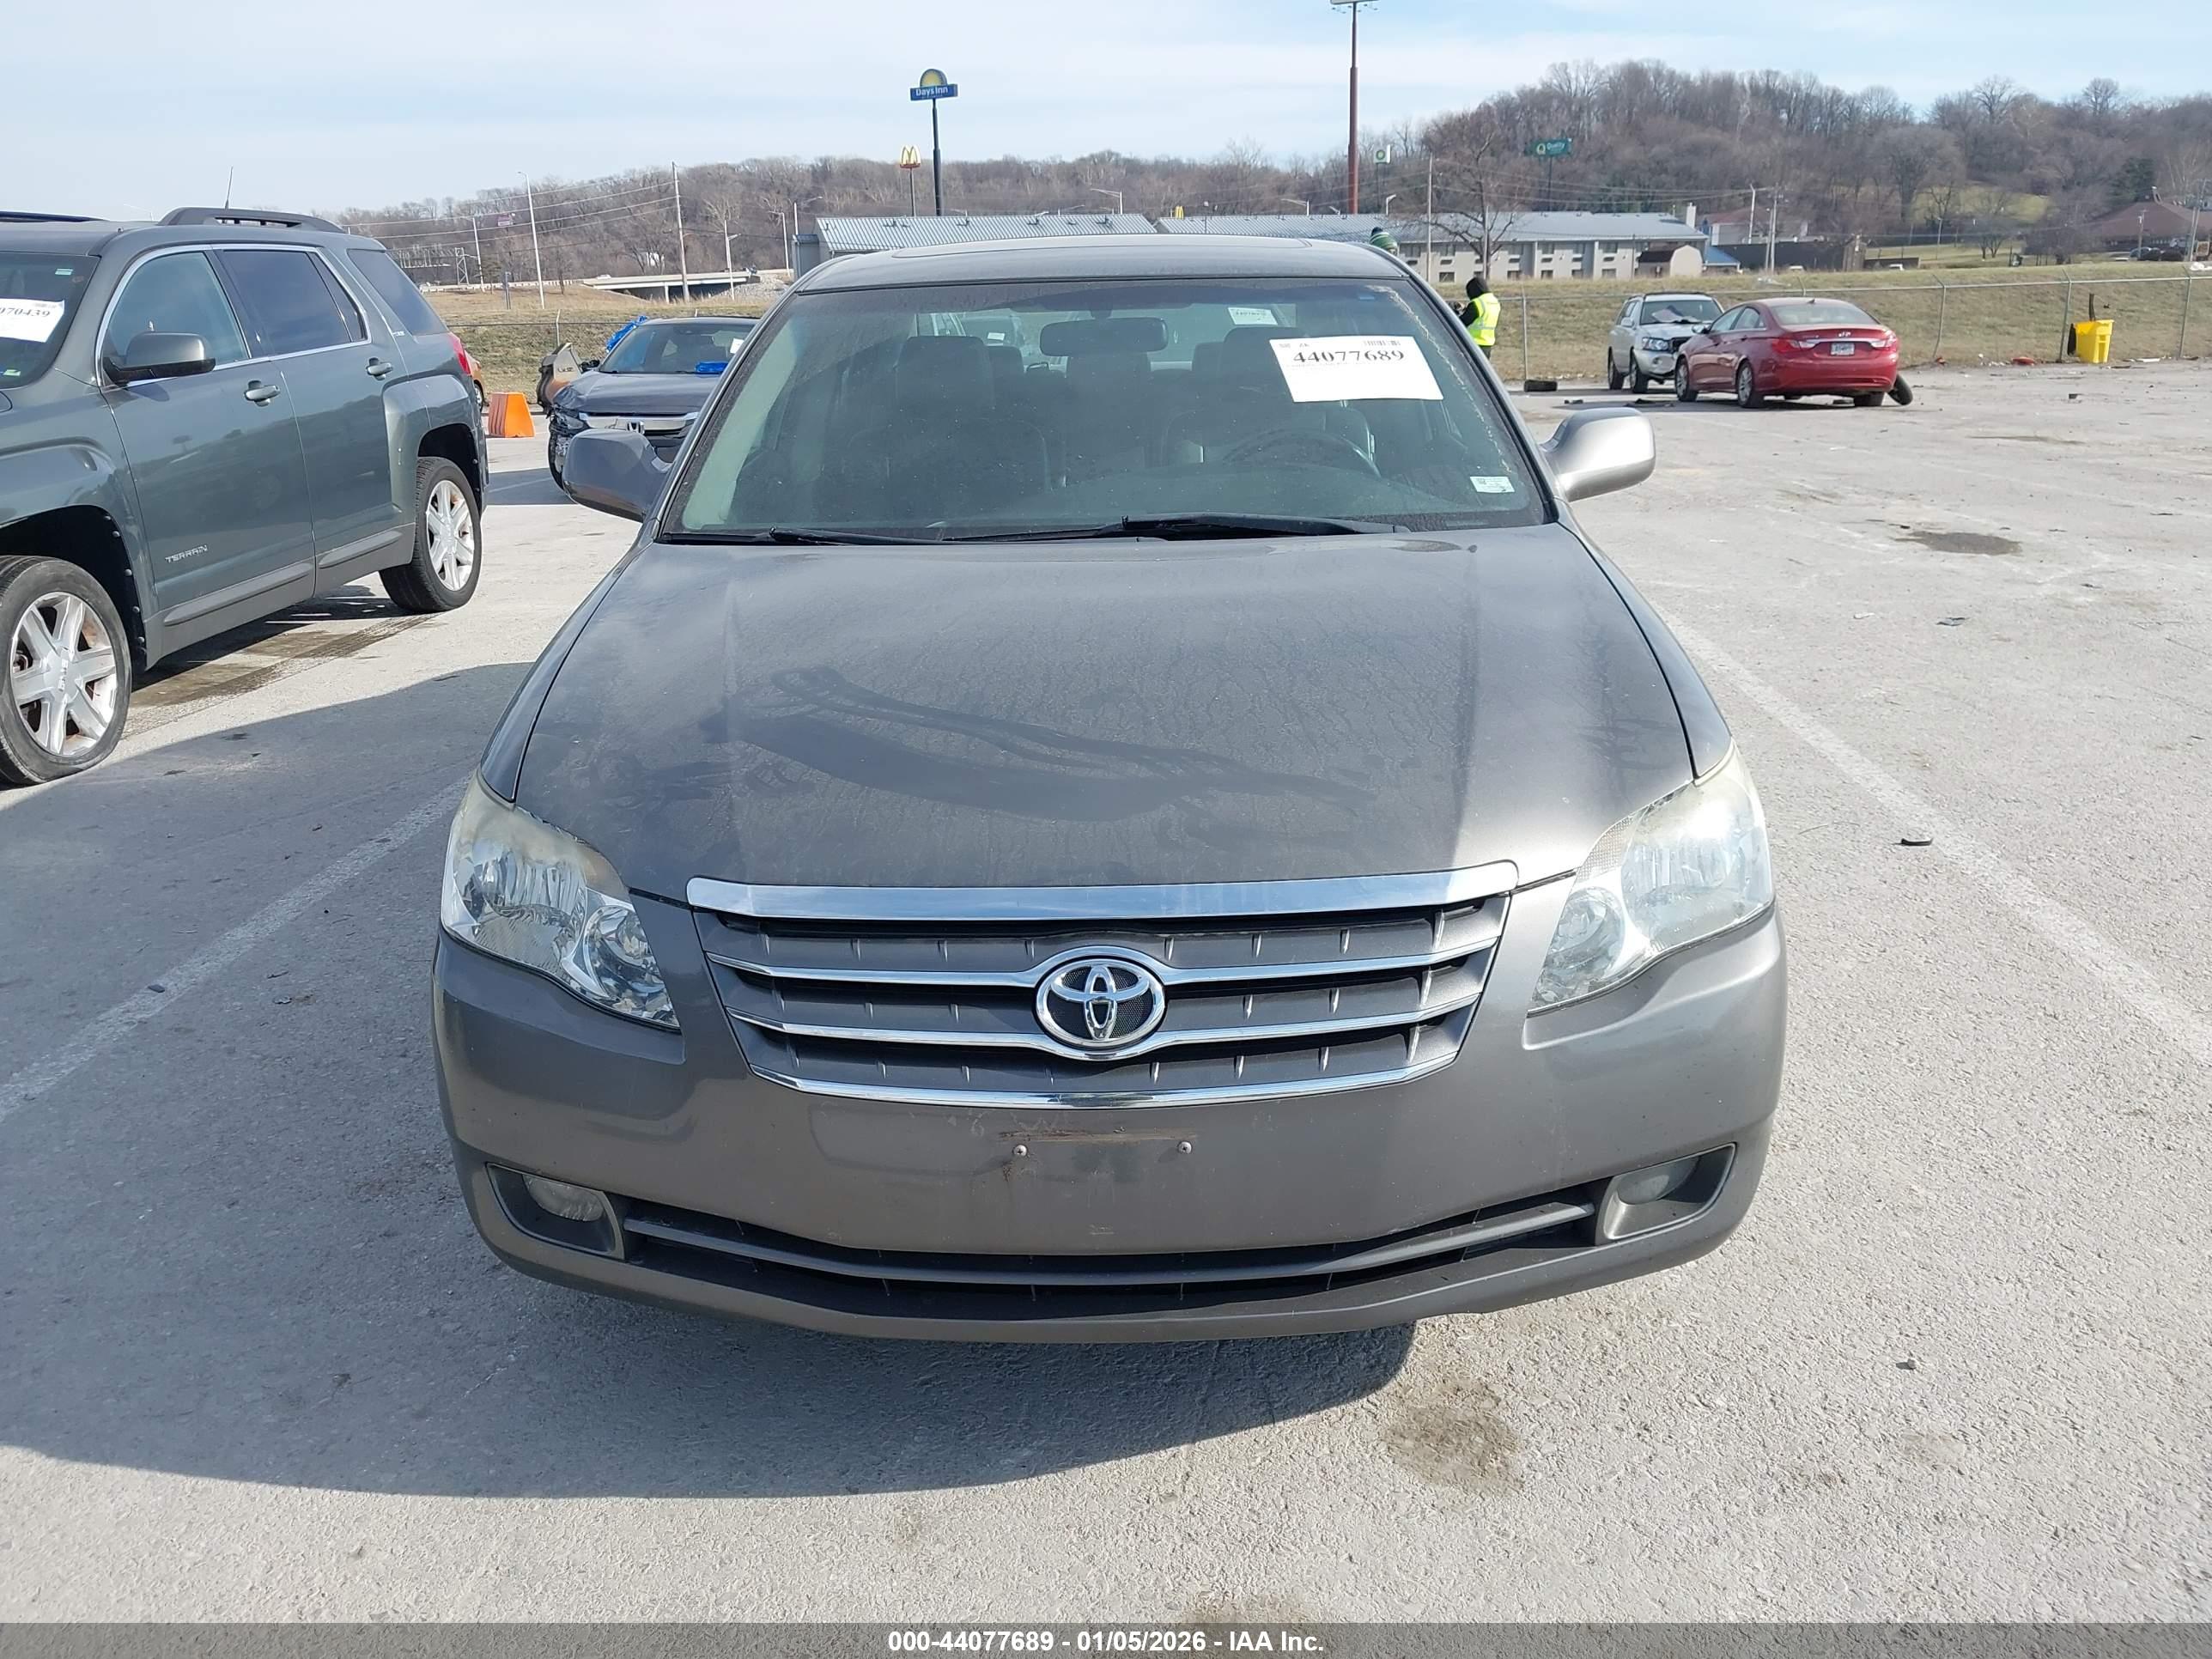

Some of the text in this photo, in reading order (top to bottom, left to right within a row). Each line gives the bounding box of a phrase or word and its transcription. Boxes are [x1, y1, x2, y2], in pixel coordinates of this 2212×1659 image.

[915, 86, 949, 97] Days Inn
[1292, 349, 1405, 363] 44077689
[165, 544, 208, 563] TERRAIN
